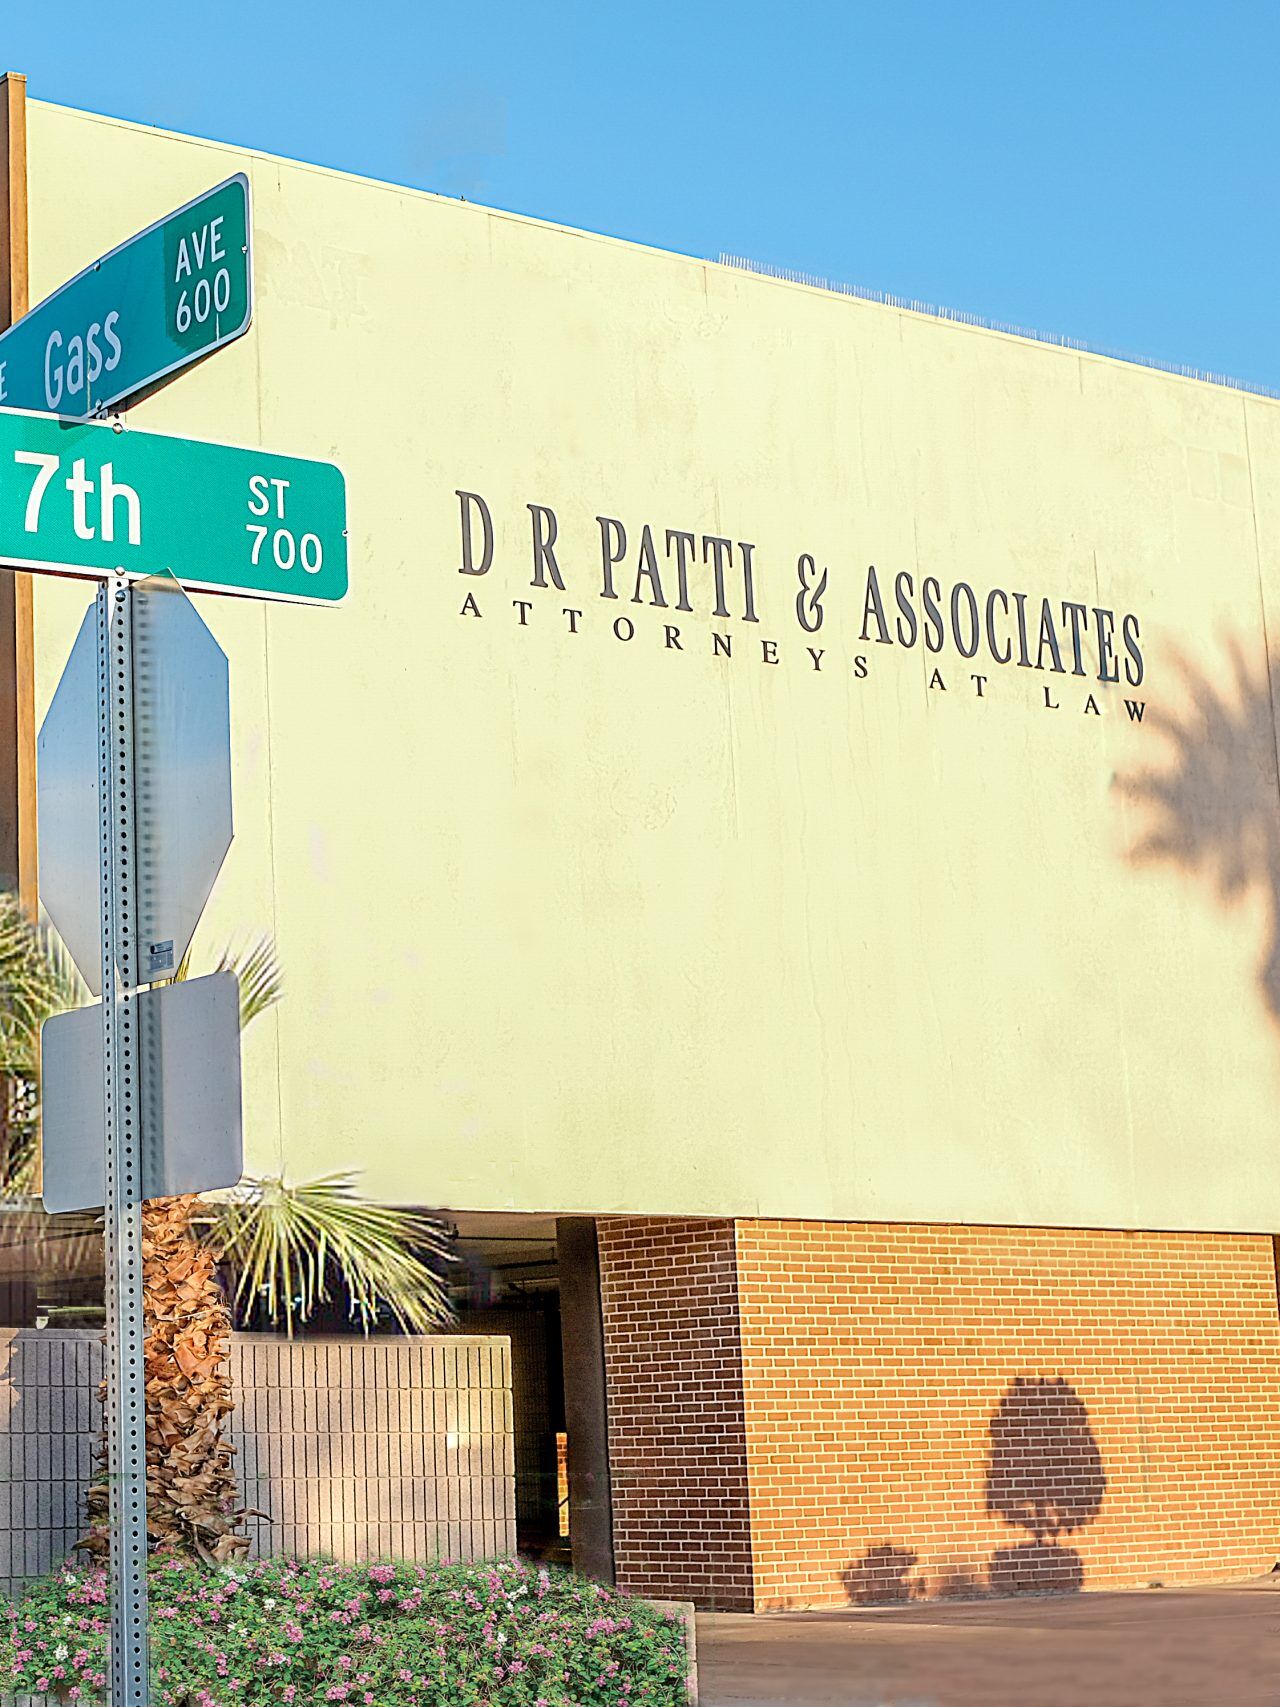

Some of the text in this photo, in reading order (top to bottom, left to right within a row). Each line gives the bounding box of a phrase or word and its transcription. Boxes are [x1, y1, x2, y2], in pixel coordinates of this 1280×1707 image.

[175, 216, 226, 283] AVE
[175, 267, 231, 333] 600
[44, 310, 122, 410] Gass
[14, 450, 141, 546] 7th
[247, 475, 290, 519] ST
[245, 524, 323, 574] 700
[455, 490, 1144, 687] D R PATTI & ASSOCIATES
[459, 592, 1146, 723] ATTORNEYS AT LAW
